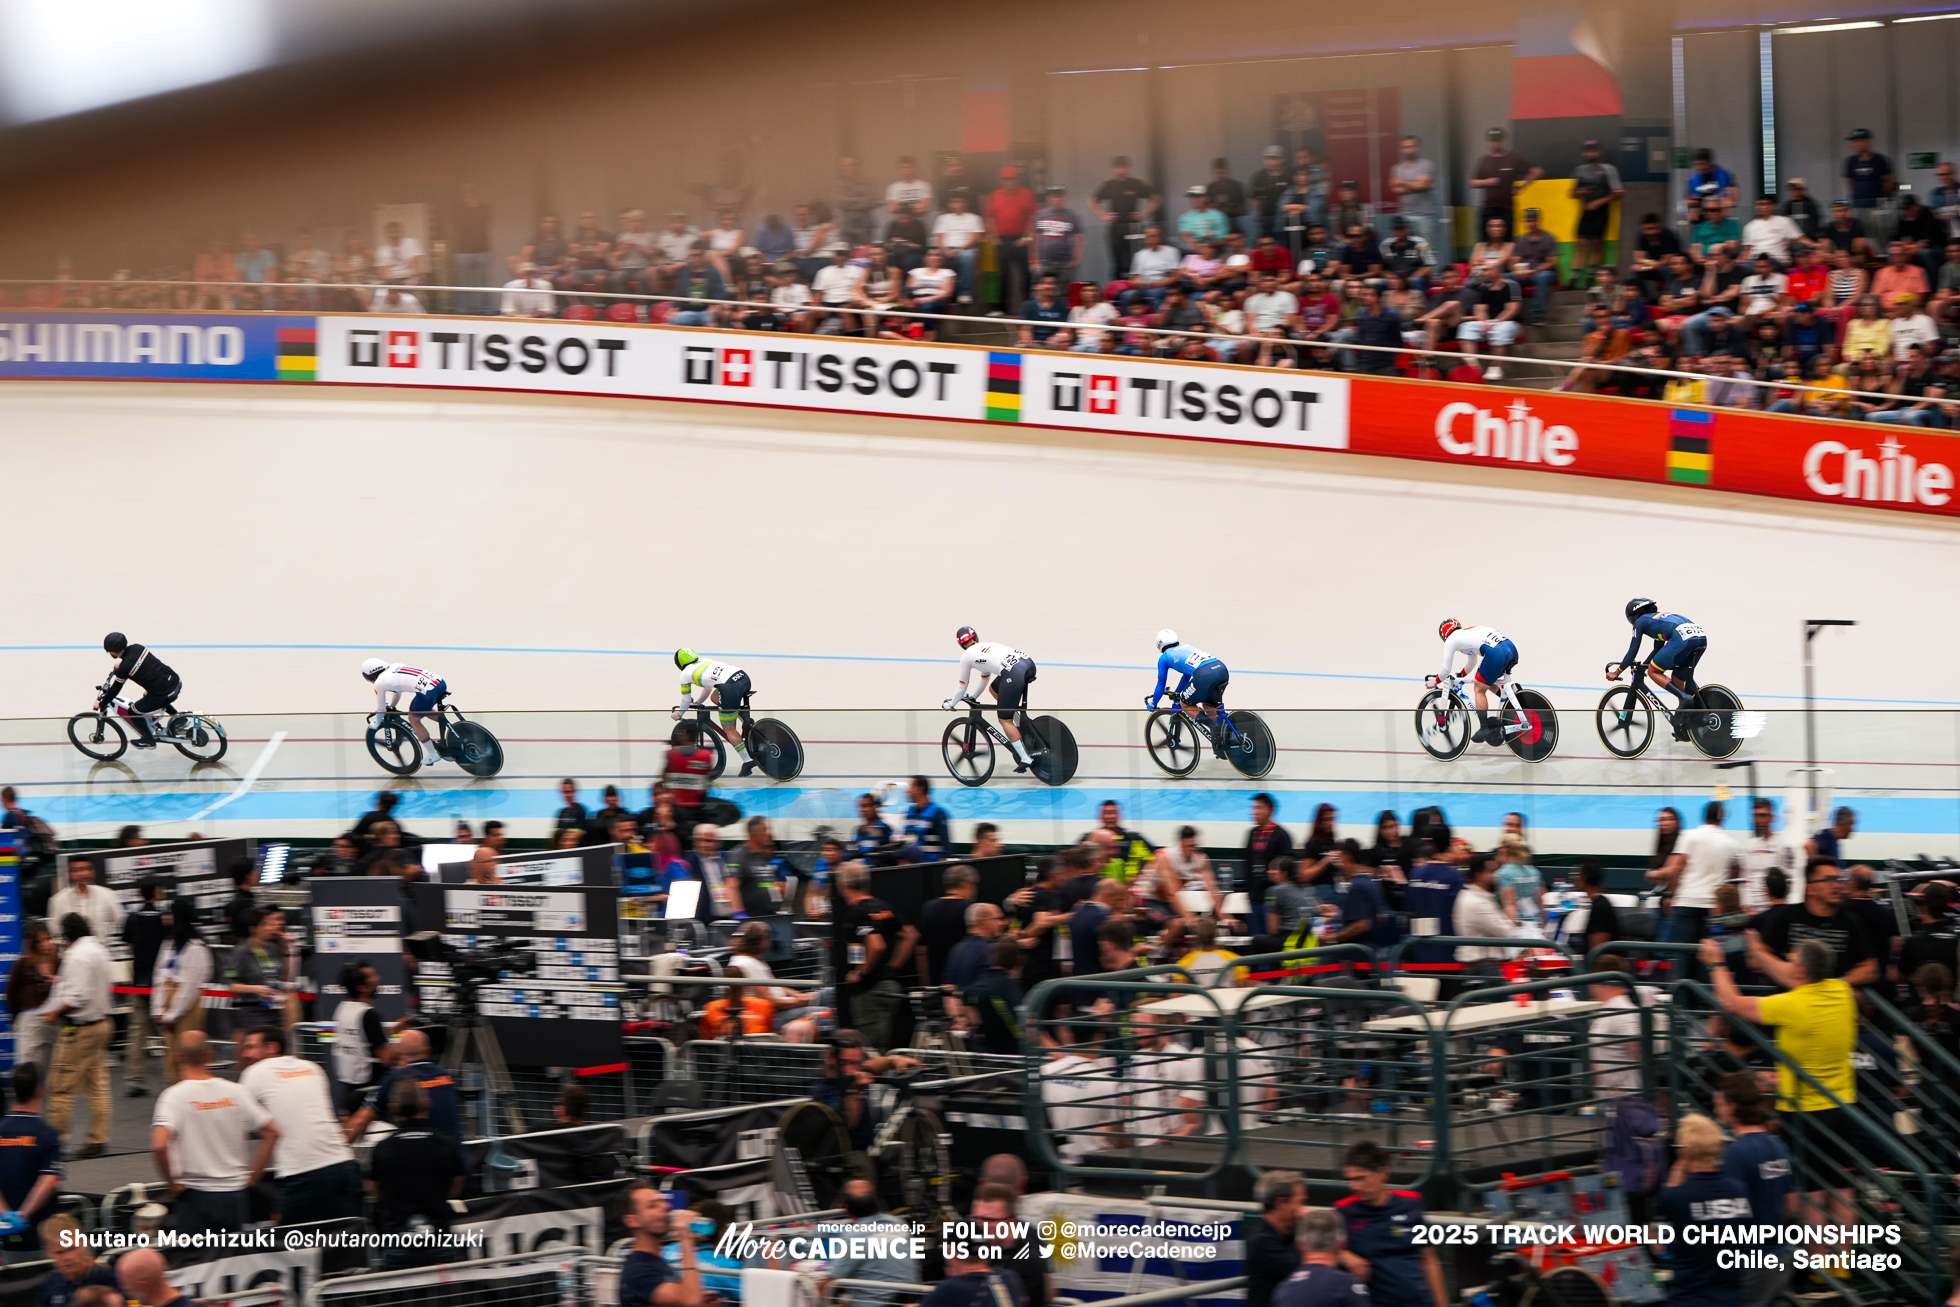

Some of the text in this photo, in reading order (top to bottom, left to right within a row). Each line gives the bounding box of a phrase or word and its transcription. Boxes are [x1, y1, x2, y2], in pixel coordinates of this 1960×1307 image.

[430, 331, 630, 377] TISSOT
[763, 350, 959, 402] TISSOT
[1130, 377, 1322, 432] TISSOT
[1435, 399, 1579, 467] Chile
[1802, 435, 1955, 506] Chile
[1645, 691, 1671, 721] KOGA
[385, 728, 393, 748] LOTUS
[987, 726, 1009, 744] FES
[1689, 1197, 1753, 1221] USA
